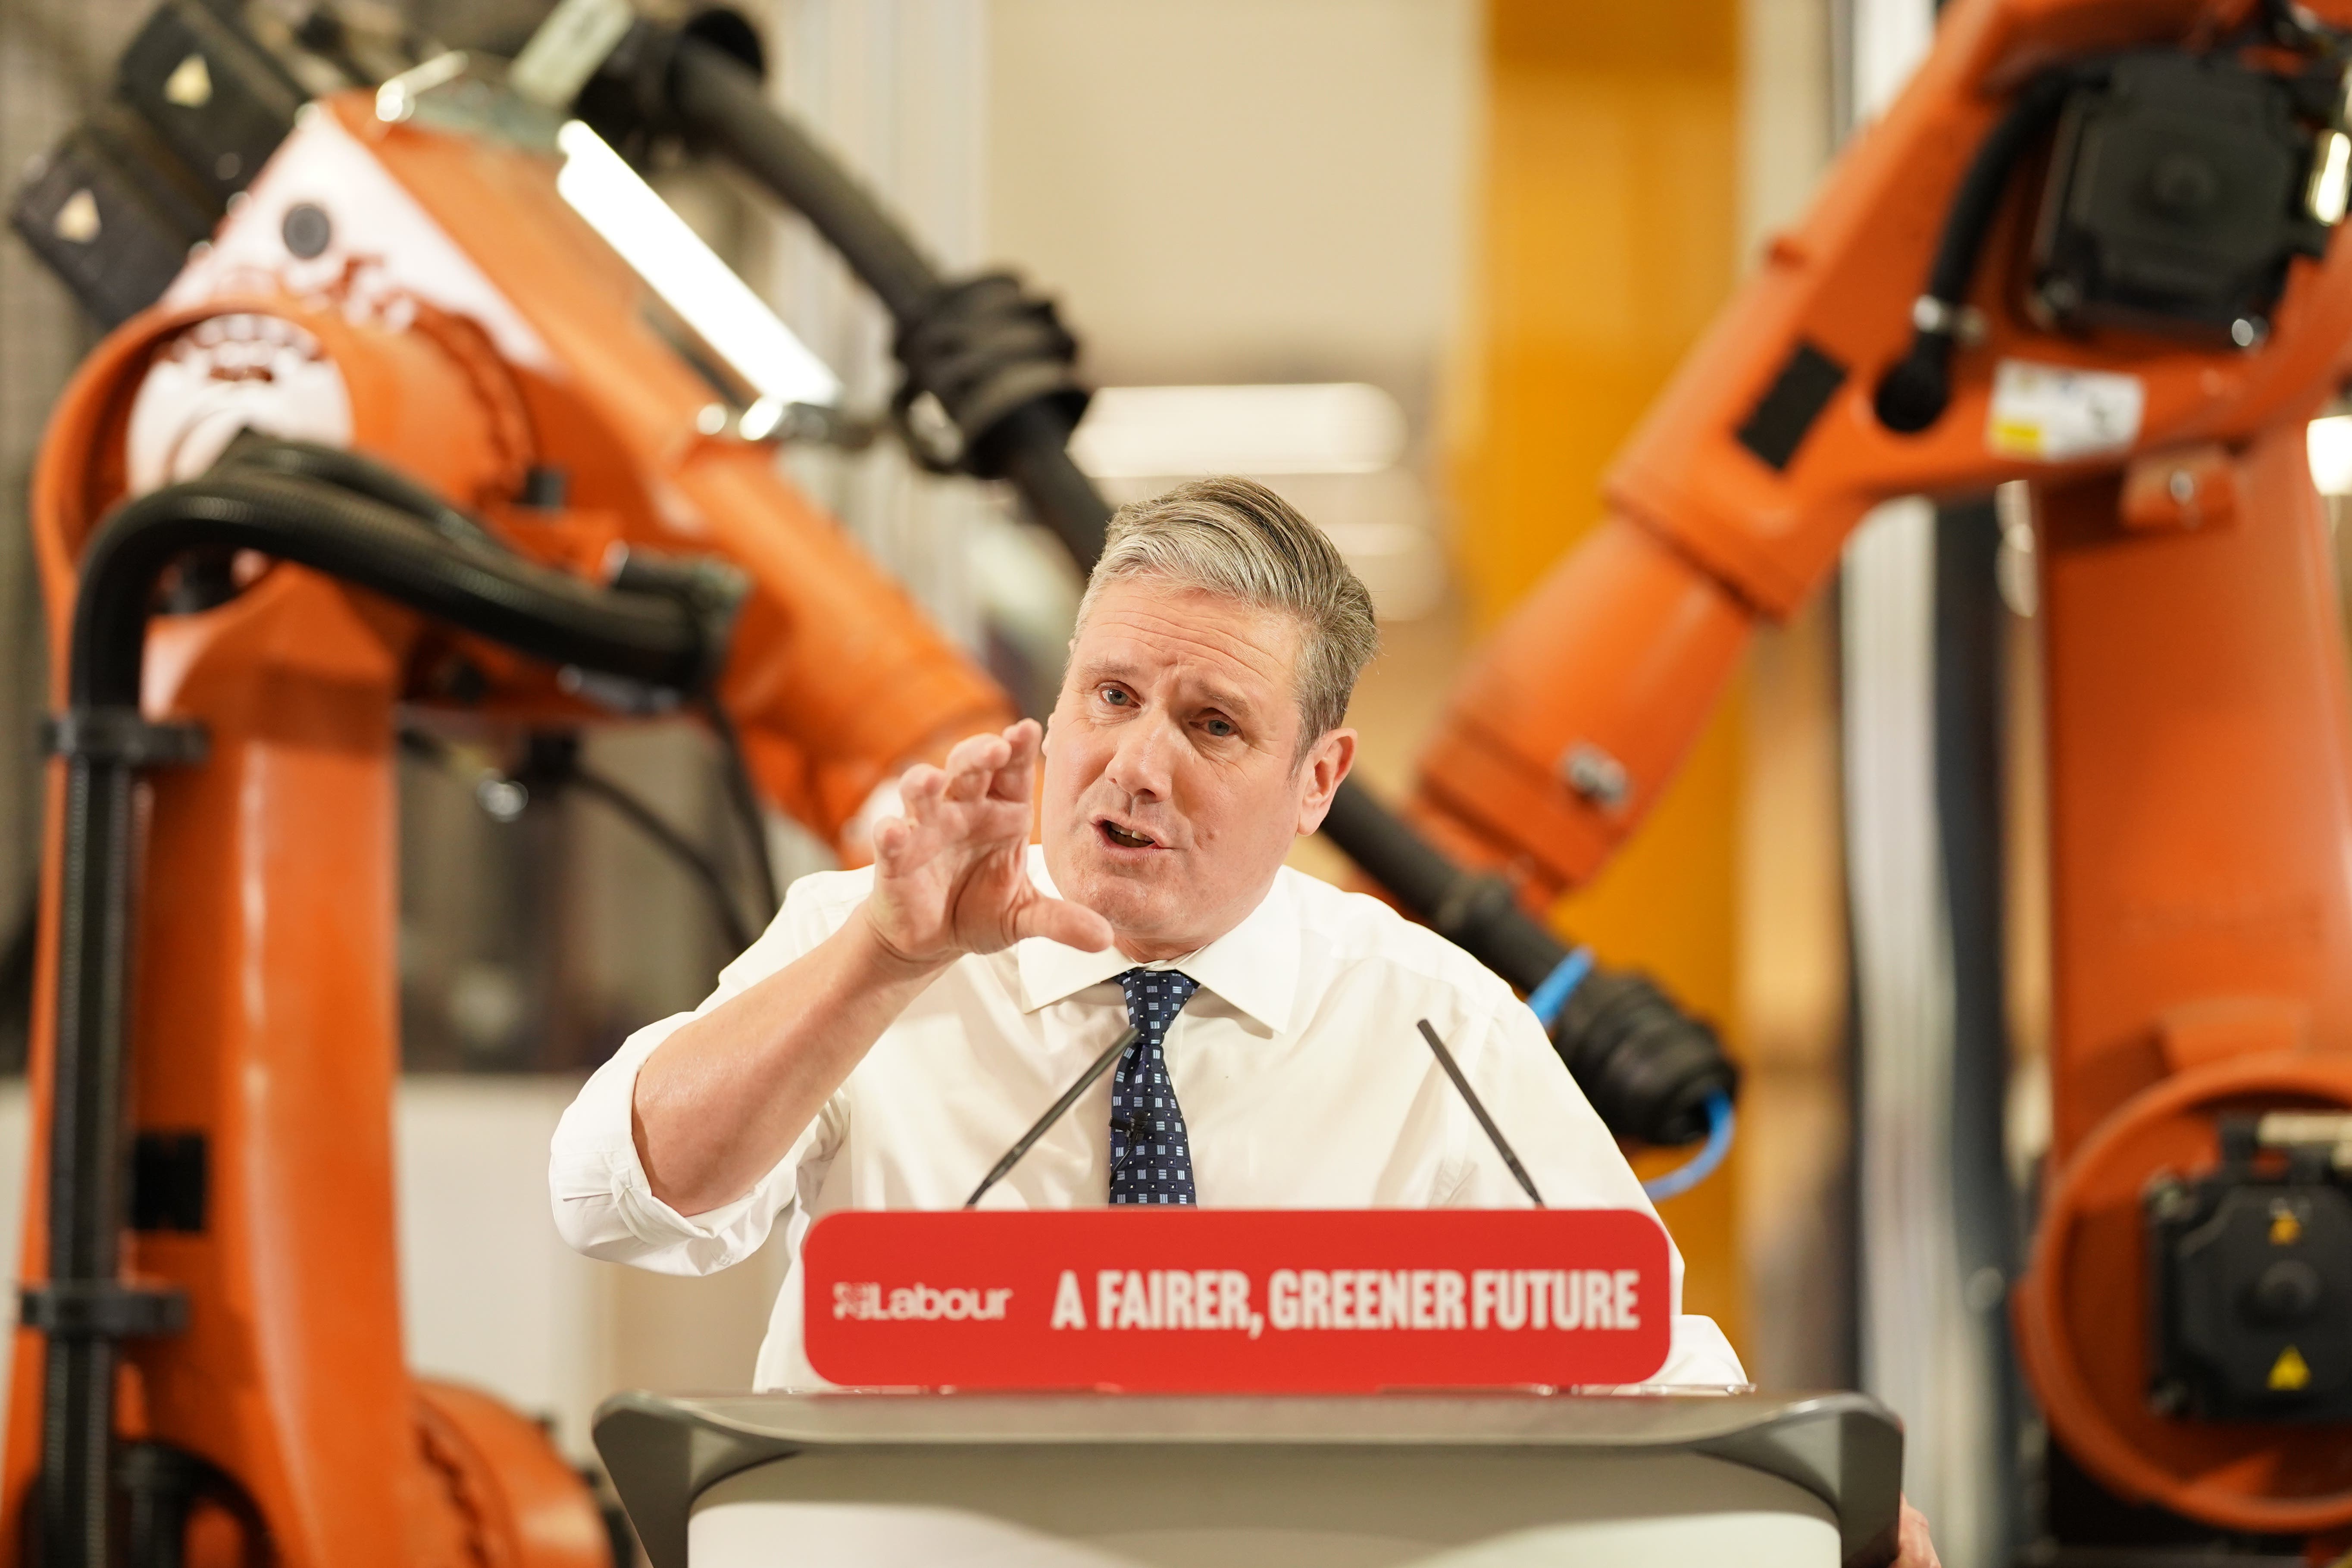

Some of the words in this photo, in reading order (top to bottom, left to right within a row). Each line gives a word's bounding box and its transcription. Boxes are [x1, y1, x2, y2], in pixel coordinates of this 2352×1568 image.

[869, 1282, 1013, 1320] Labour
[1050, 1269, 1087, 1330] A
[1096, 1269, 1265, 1339] FAIRER,
[1267, 1269, 1467, 1331] GREENER
[1471, 1269, 1641, 1331] FUTURE
